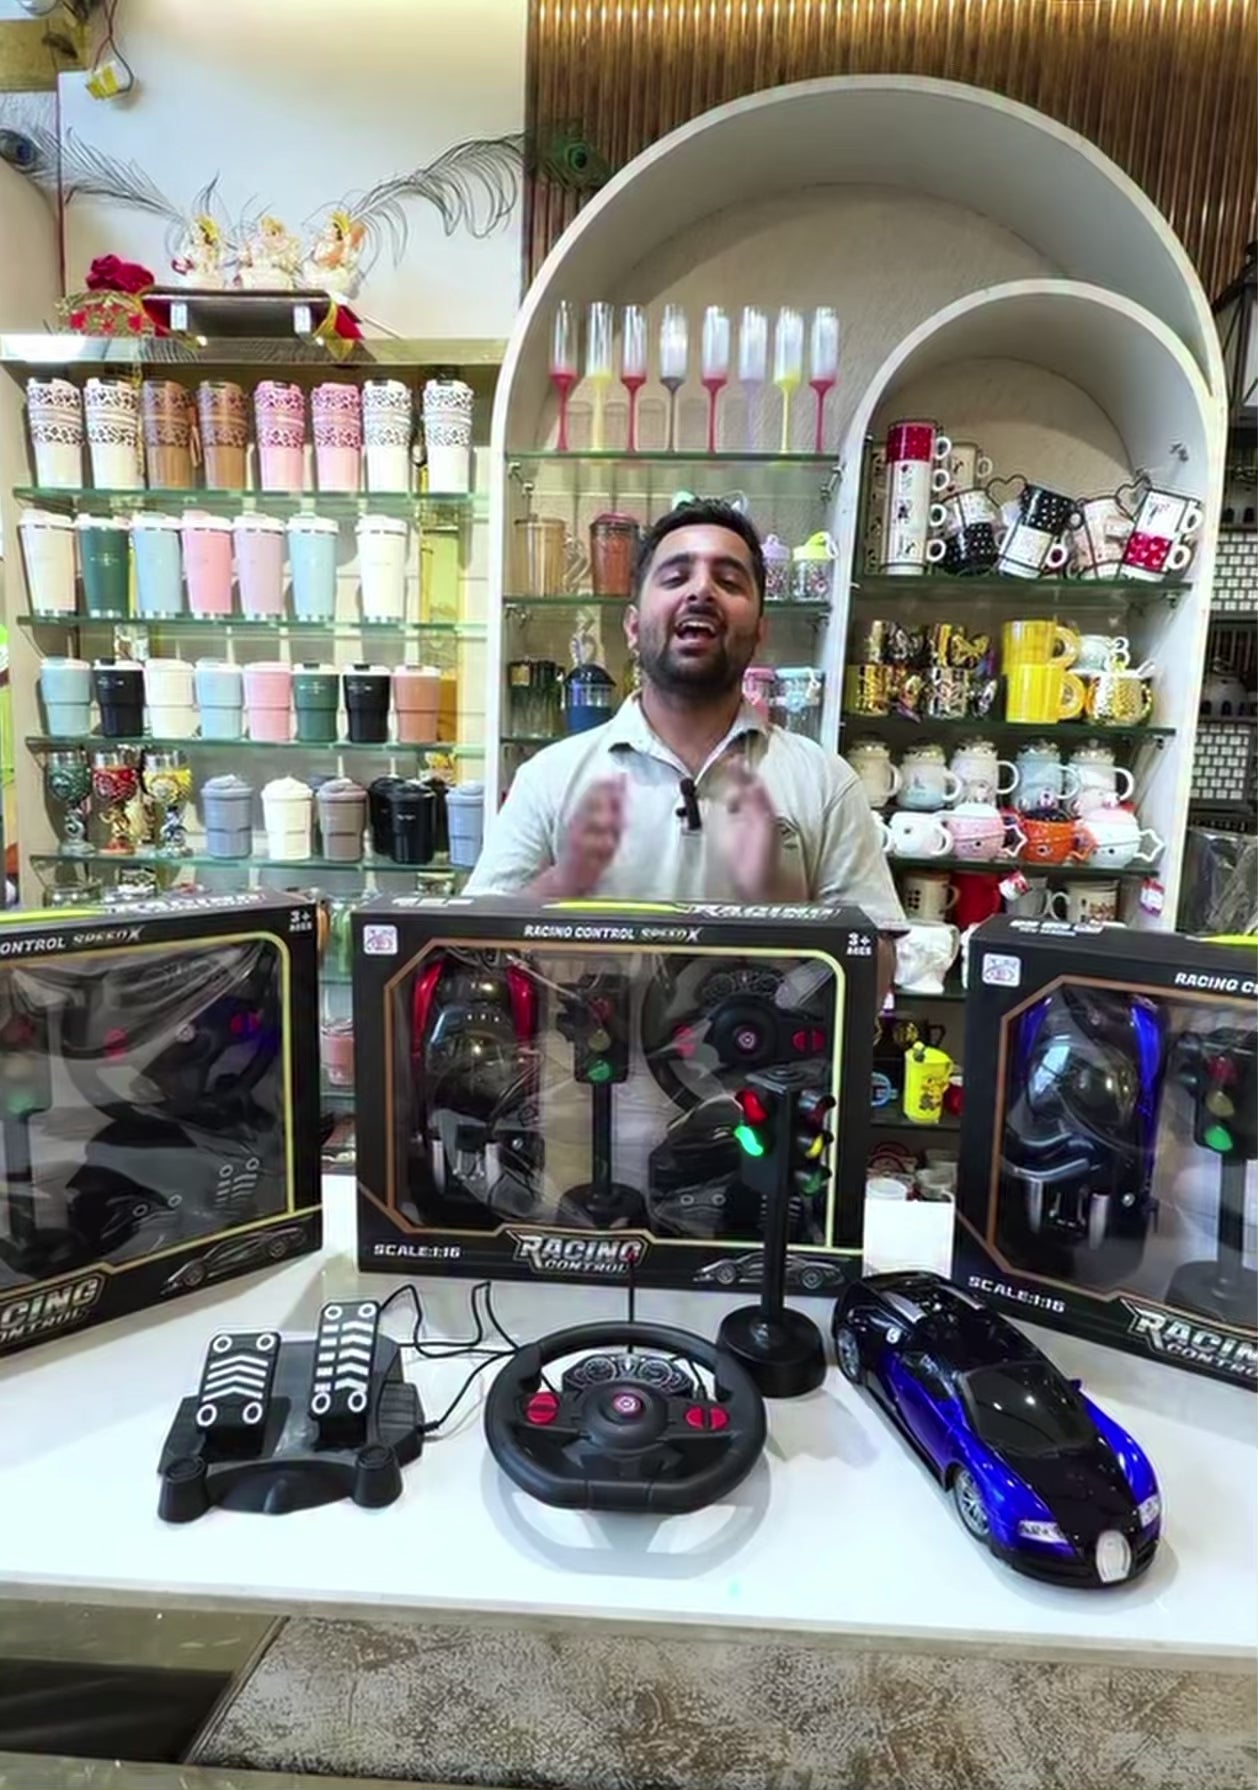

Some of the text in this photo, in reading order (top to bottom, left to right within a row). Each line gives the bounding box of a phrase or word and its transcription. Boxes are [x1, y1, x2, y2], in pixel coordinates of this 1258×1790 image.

[524, 923, 571, 938] RACING
[574, 925, 635, 941] CONTROL
[848, 932, 871, 946] 3+
[1174, 971, 1239, 992] RACING
[515, 1234, 643, 1268] RACING
[545, 1258, 629, 1273] CONTROL
